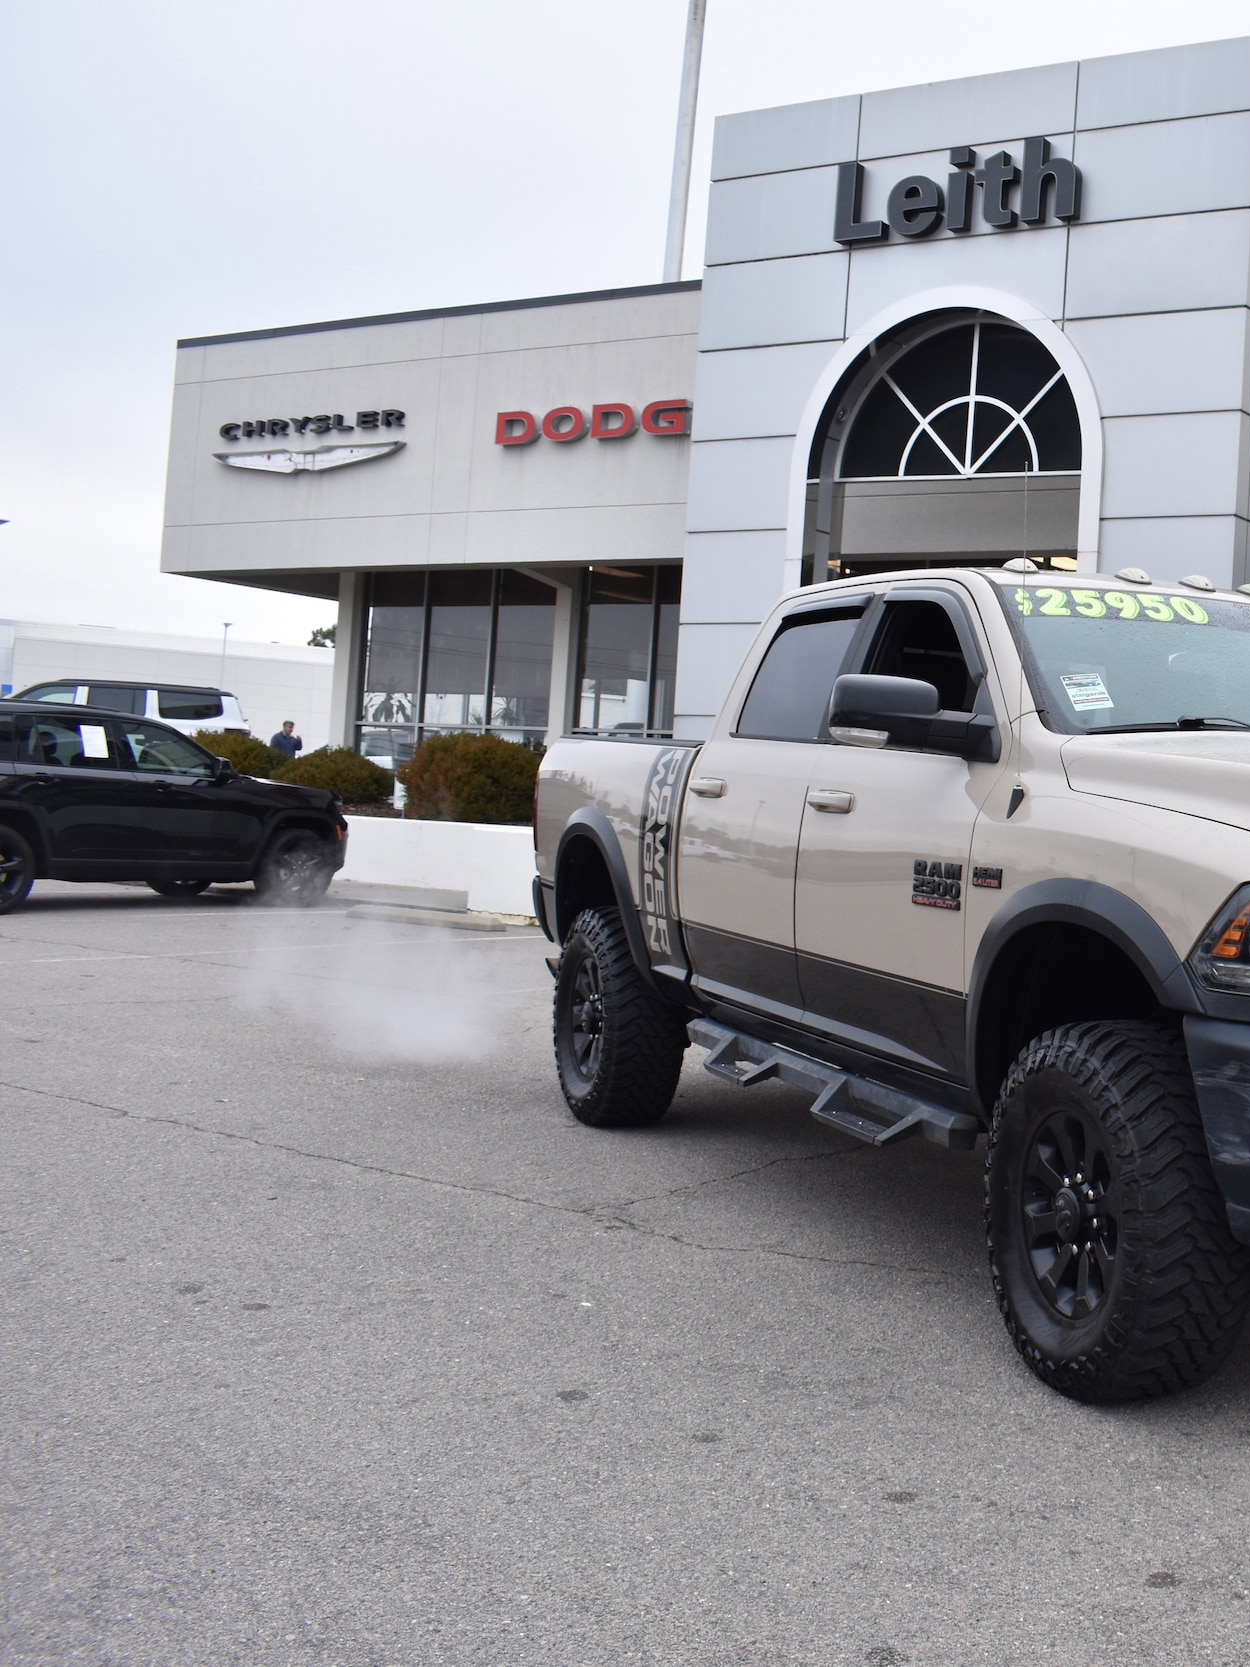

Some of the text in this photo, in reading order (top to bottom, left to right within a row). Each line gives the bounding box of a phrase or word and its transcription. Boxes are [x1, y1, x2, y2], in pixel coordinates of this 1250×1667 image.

[833, 136, 1083, 246] Leith
[219, 408, 406, 441] CHRYSLER
[1015, 588, 1209, 624] $25950
[644, 750, 676, 953] WAGON
[654, 750, 686, 955] POWER
[914, 860, 963, 881] RAM
[973, 867, 1002, 879] HEMI
[912, 877, 961, 899] 2500
[912, 895, 957, 908] HEAVY DUTY
